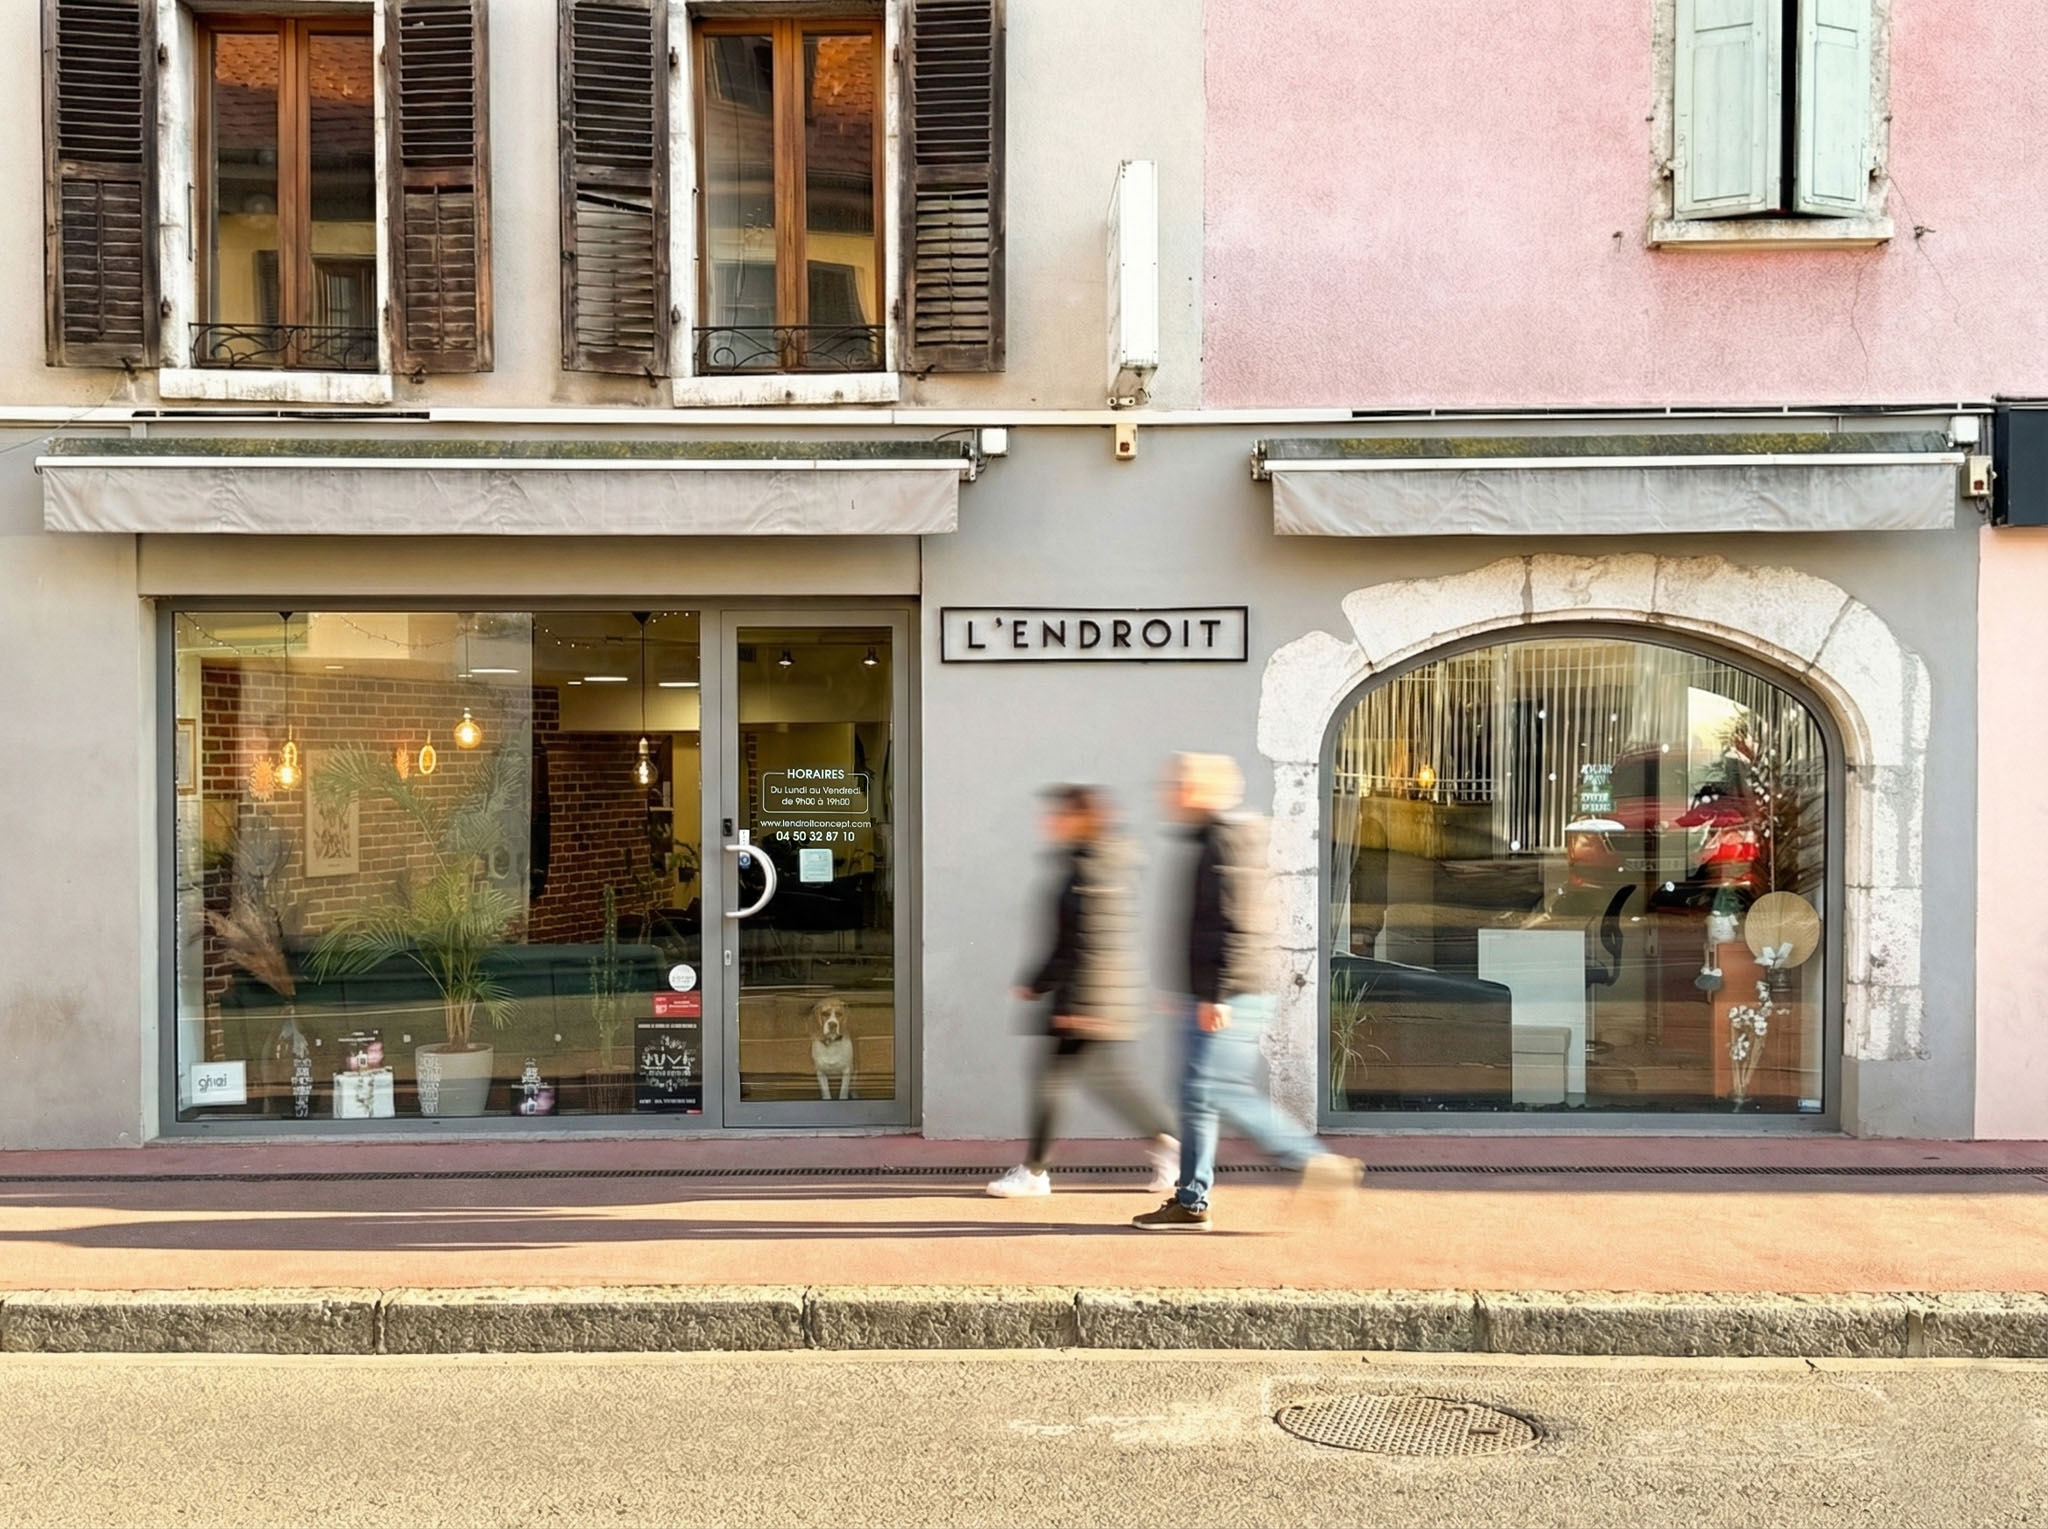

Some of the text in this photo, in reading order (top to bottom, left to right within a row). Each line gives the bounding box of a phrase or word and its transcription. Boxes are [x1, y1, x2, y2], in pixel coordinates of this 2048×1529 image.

[967, 617, 1221, 649] L'ENDROIT
[787, 769, 845, 780] HORAIRES
[770, 786, 782, 794] Du
[785, 786, 808, 794] Lundi
[823, 786, 861, 795] Vendredi
[781, 798, 793, 806] de
[795, 798, 816, 806] 9h00
[826, 798, 850, 806] 19h00
[760, 819, 872, 829] www.lendroitconcept.com
[776, 831, 855, 841] 04 50 32 87 10
